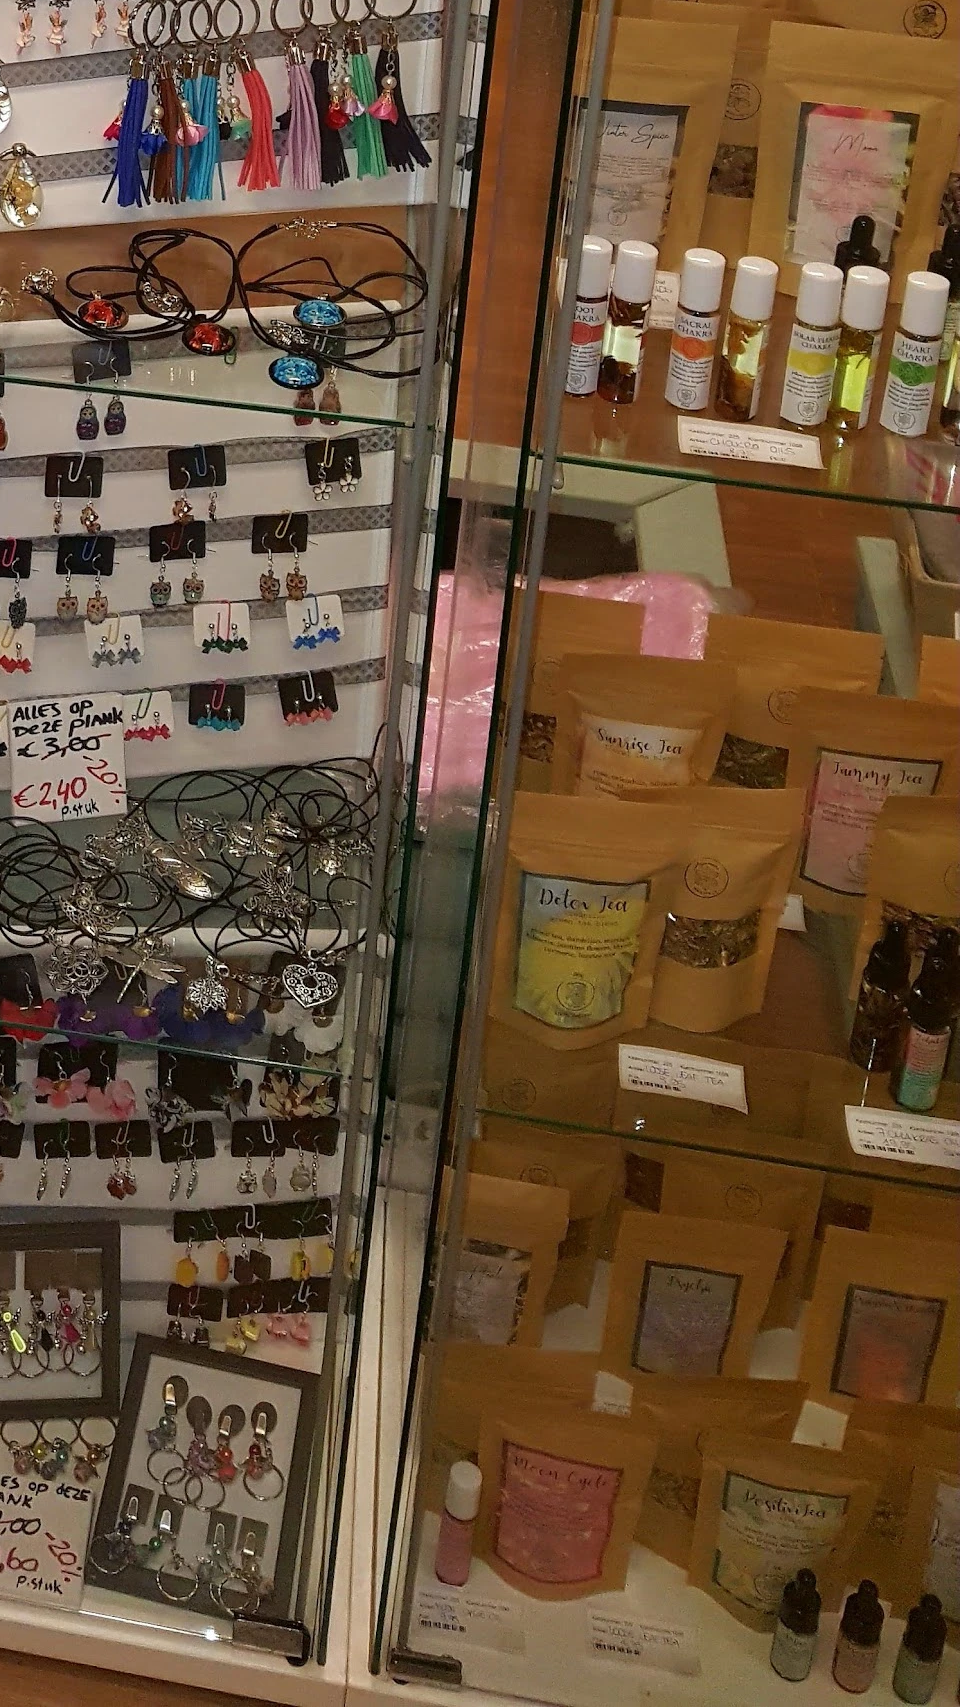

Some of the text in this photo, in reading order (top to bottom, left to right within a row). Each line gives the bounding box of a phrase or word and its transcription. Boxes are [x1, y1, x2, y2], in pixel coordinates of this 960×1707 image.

[630, 123, 671, 150] Spice
[575, 305, 595, 315] OOT
[680, 315, 712, 330] SACRAL
[677, 324, 713, 338] CHAKRA
[901, 340, 932, 354] HEART
[896, 348, 934, 363] CHAKRA
[598, 727, 651, 754] Sunrise
[659, 739, 683, 755] Tea
[900, 770, 923, 785] Tea
[598, 895, 628, 914] Tea
